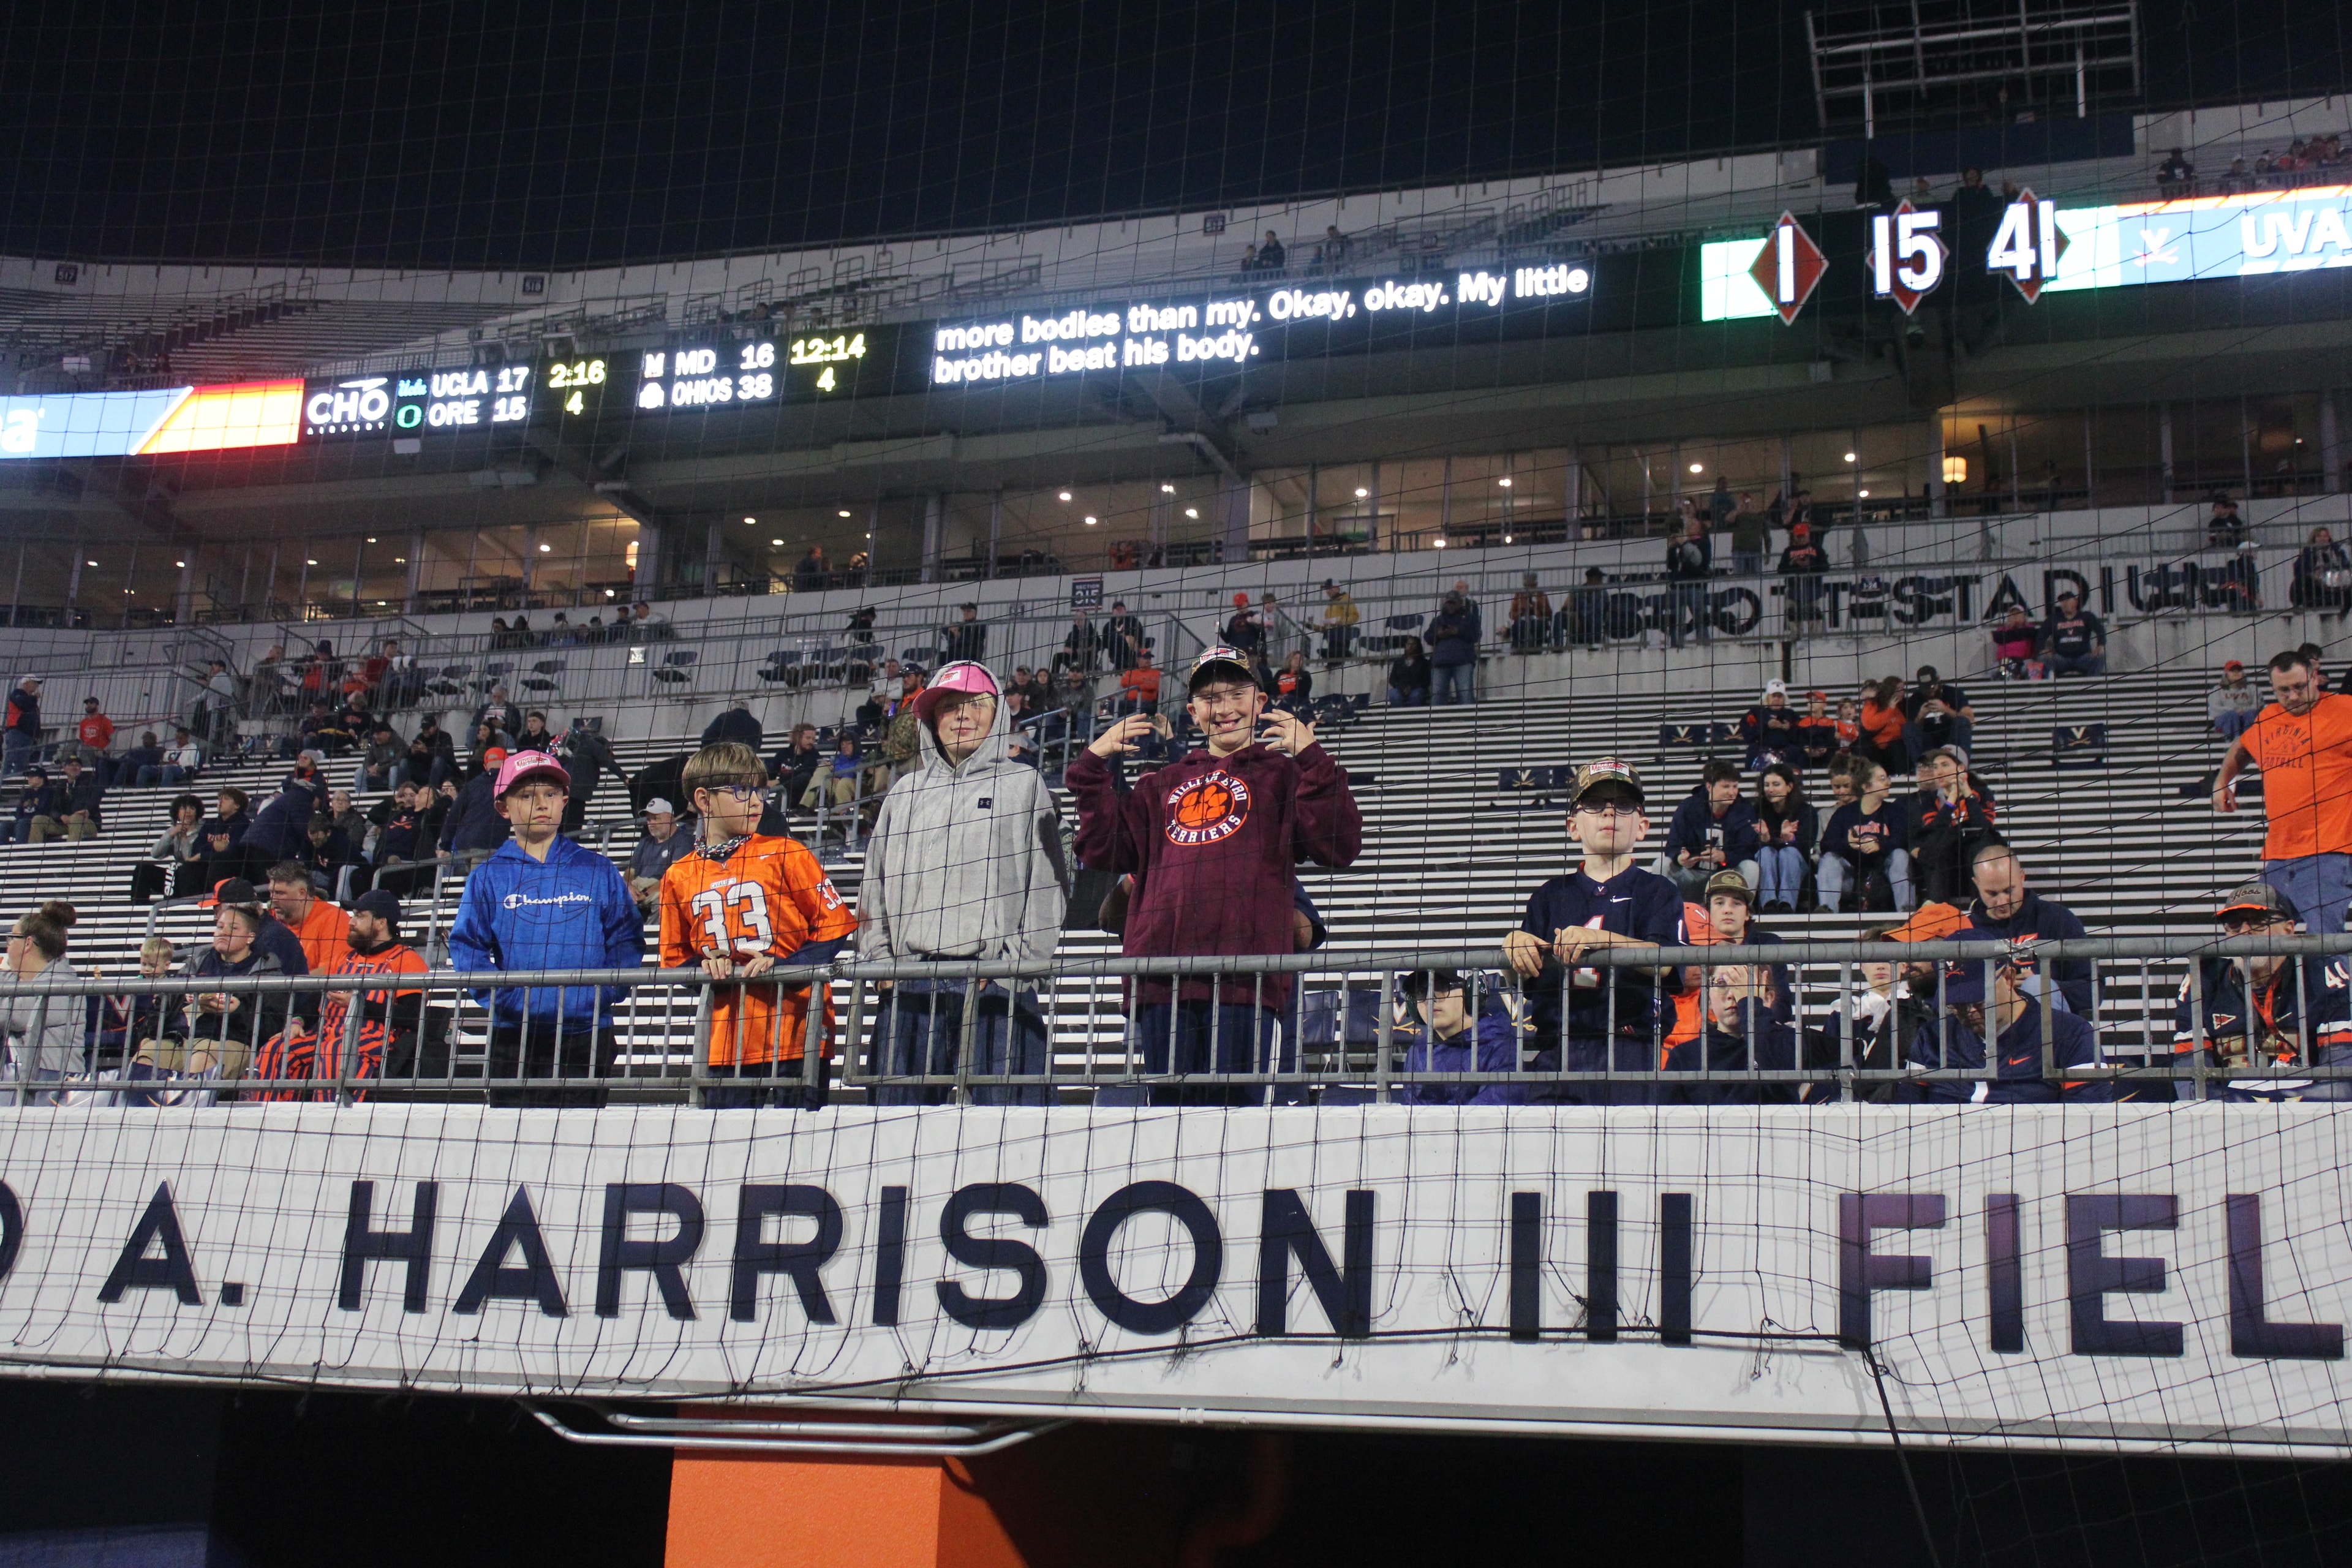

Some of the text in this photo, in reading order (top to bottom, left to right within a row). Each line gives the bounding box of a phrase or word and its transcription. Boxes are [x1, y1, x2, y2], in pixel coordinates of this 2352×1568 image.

[1873, 211, 1942, 301] 15
[1987, 200, 2056, 281] 41
[937, 265, 1588, 351] more bodies than my. Okay, okay. My little
[675, 350, 715, 375] MD
[740, 344, 774, 369] 16
[790, 334, 865, 365] 12:14
[935, 330, 1259, 383] brother beat his body.
[432, 371, 488, 397] UCLA
[497, 367, 529, 392] 17
[549, 360, 605, 388] 2:16
[672, 367, 835, 405] OHIOS 38 4
[307, 388, 389, 424] CHO
[428, 400, 478, 427] ORE
[493, 396, 526, 421] 15
[565, 391, 583, 415] 4
[517, 756, 537, 766] TIGER
[1221, 777, 1247, 801] BYRD
[1167, 815, 1241, 843] TERRIERS
[503, 892, 592, 909] Champion
[816, 878, 843, 910] 33
[2231, 889, 2261, 902] Hoos
[692, 881, 773, 958] 33
[97, 1178, 244, 1305] A.
[339, 1180, 1374, 1339] HARRISON
[1510, 1190, 1692, 1345] III
[1839, 1194, 2344, 1359] FIEL
